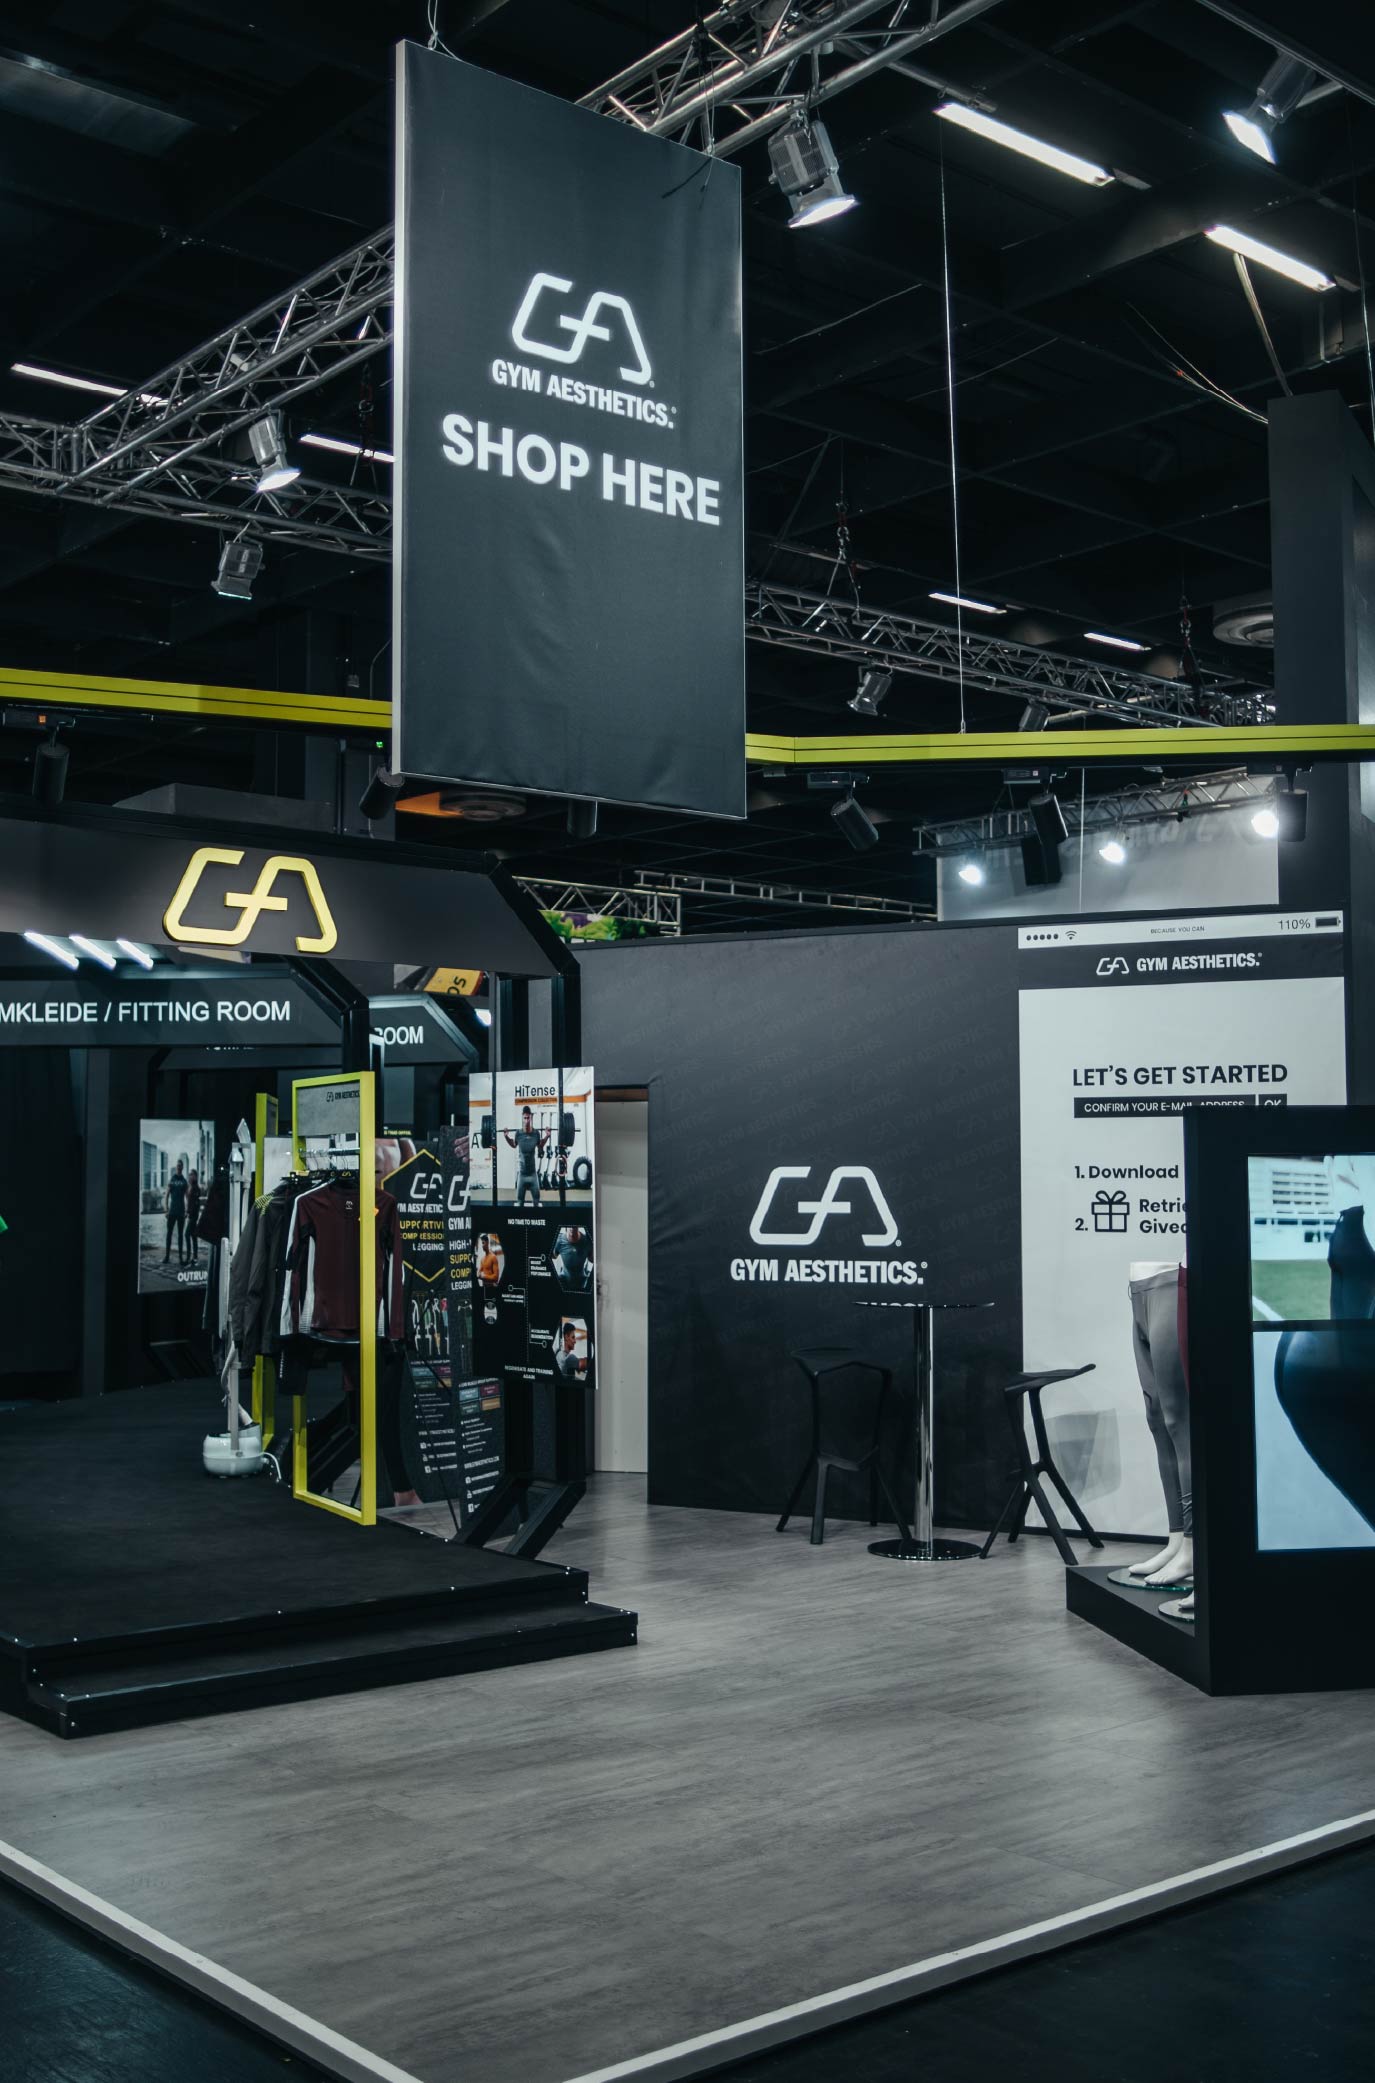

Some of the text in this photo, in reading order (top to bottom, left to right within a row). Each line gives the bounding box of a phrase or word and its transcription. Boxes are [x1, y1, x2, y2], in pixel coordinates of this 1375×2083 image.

[492, 359, 542, 394] GYM
[442, 413, 721, 527] SHOP HERE
[1278, 918, 1311, 931] 110%
[1136, 957, 1168, 972] GYM
[104, 1002, 111, 1022] /
[118, 1001, 209, 1022] FITTING
[217, 1000, 290, 1021] ROOM
[1073, 1064, 1288, 1086] LET’S GET STARTED
[514, 1084, 556, 1097] HiTense
[1084, 1103, 1130, 1113] CONFIRM
[1131, 1102, 1159, 1112] YOUR
[1074, 1165, 1179, 1179] 1. Download
[448, 1217, 464, 1230] GYM
[1075, 1218, 1089, 1231] 2.
[730, 1258, 779, 1282] GYM
